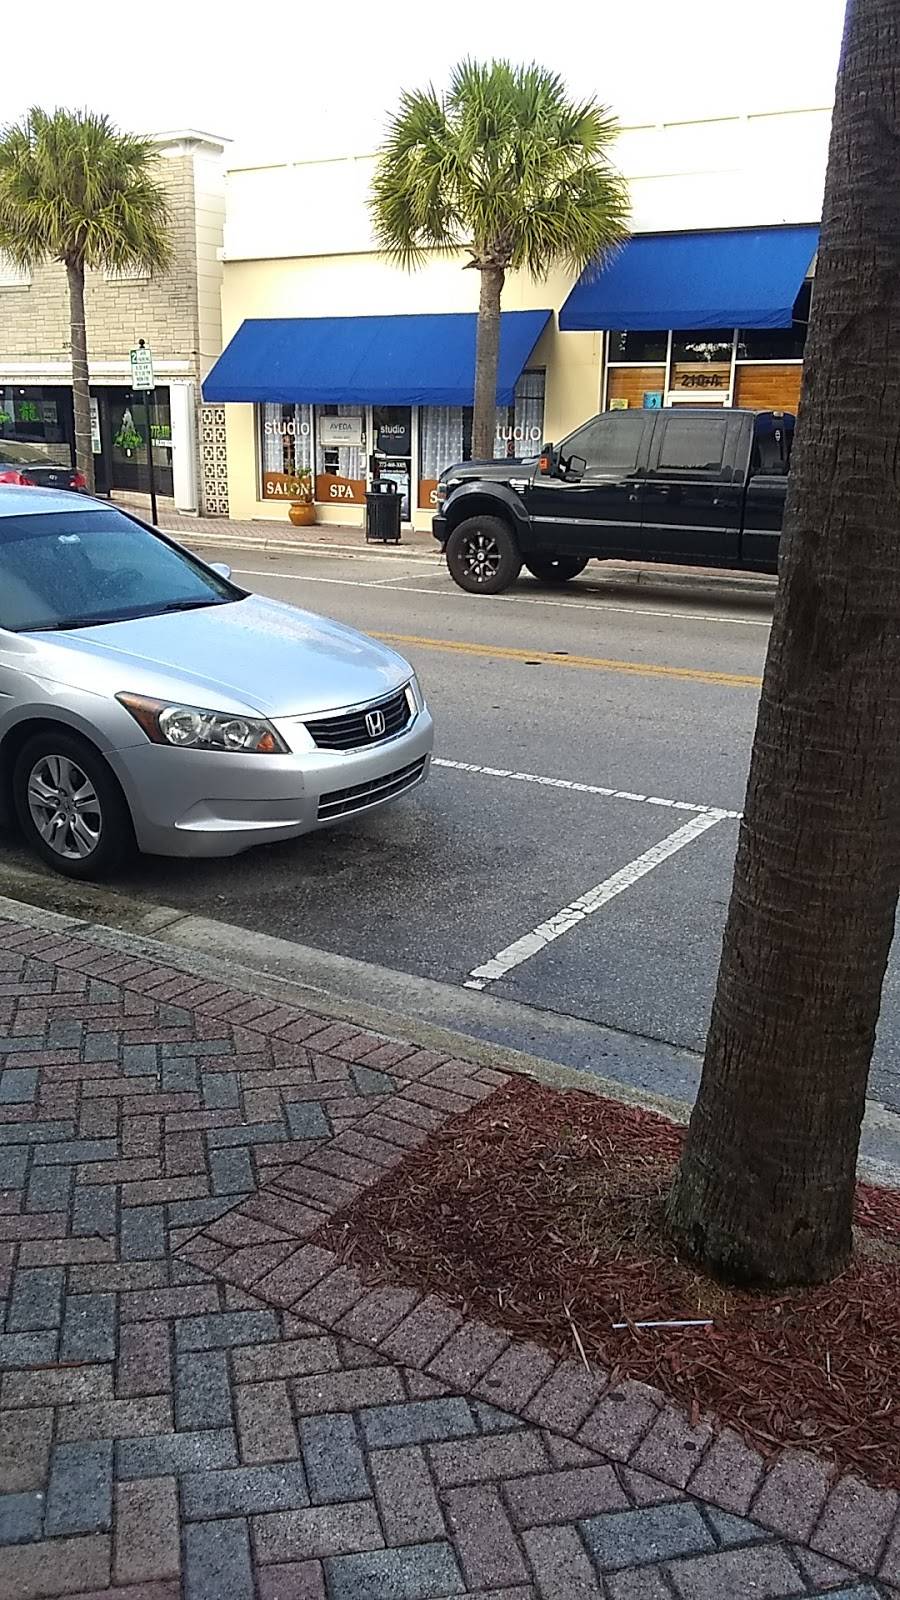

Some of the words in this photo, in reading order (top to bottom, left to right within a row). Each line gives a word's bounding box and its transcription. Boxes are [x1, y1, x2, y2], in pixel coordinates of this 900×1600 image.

[264, 418, 310, 436] studio
[380, 424, 406, 434] studio
[495, 422, 542, 441] tudio
[329, 484, 355, 499] SPA
